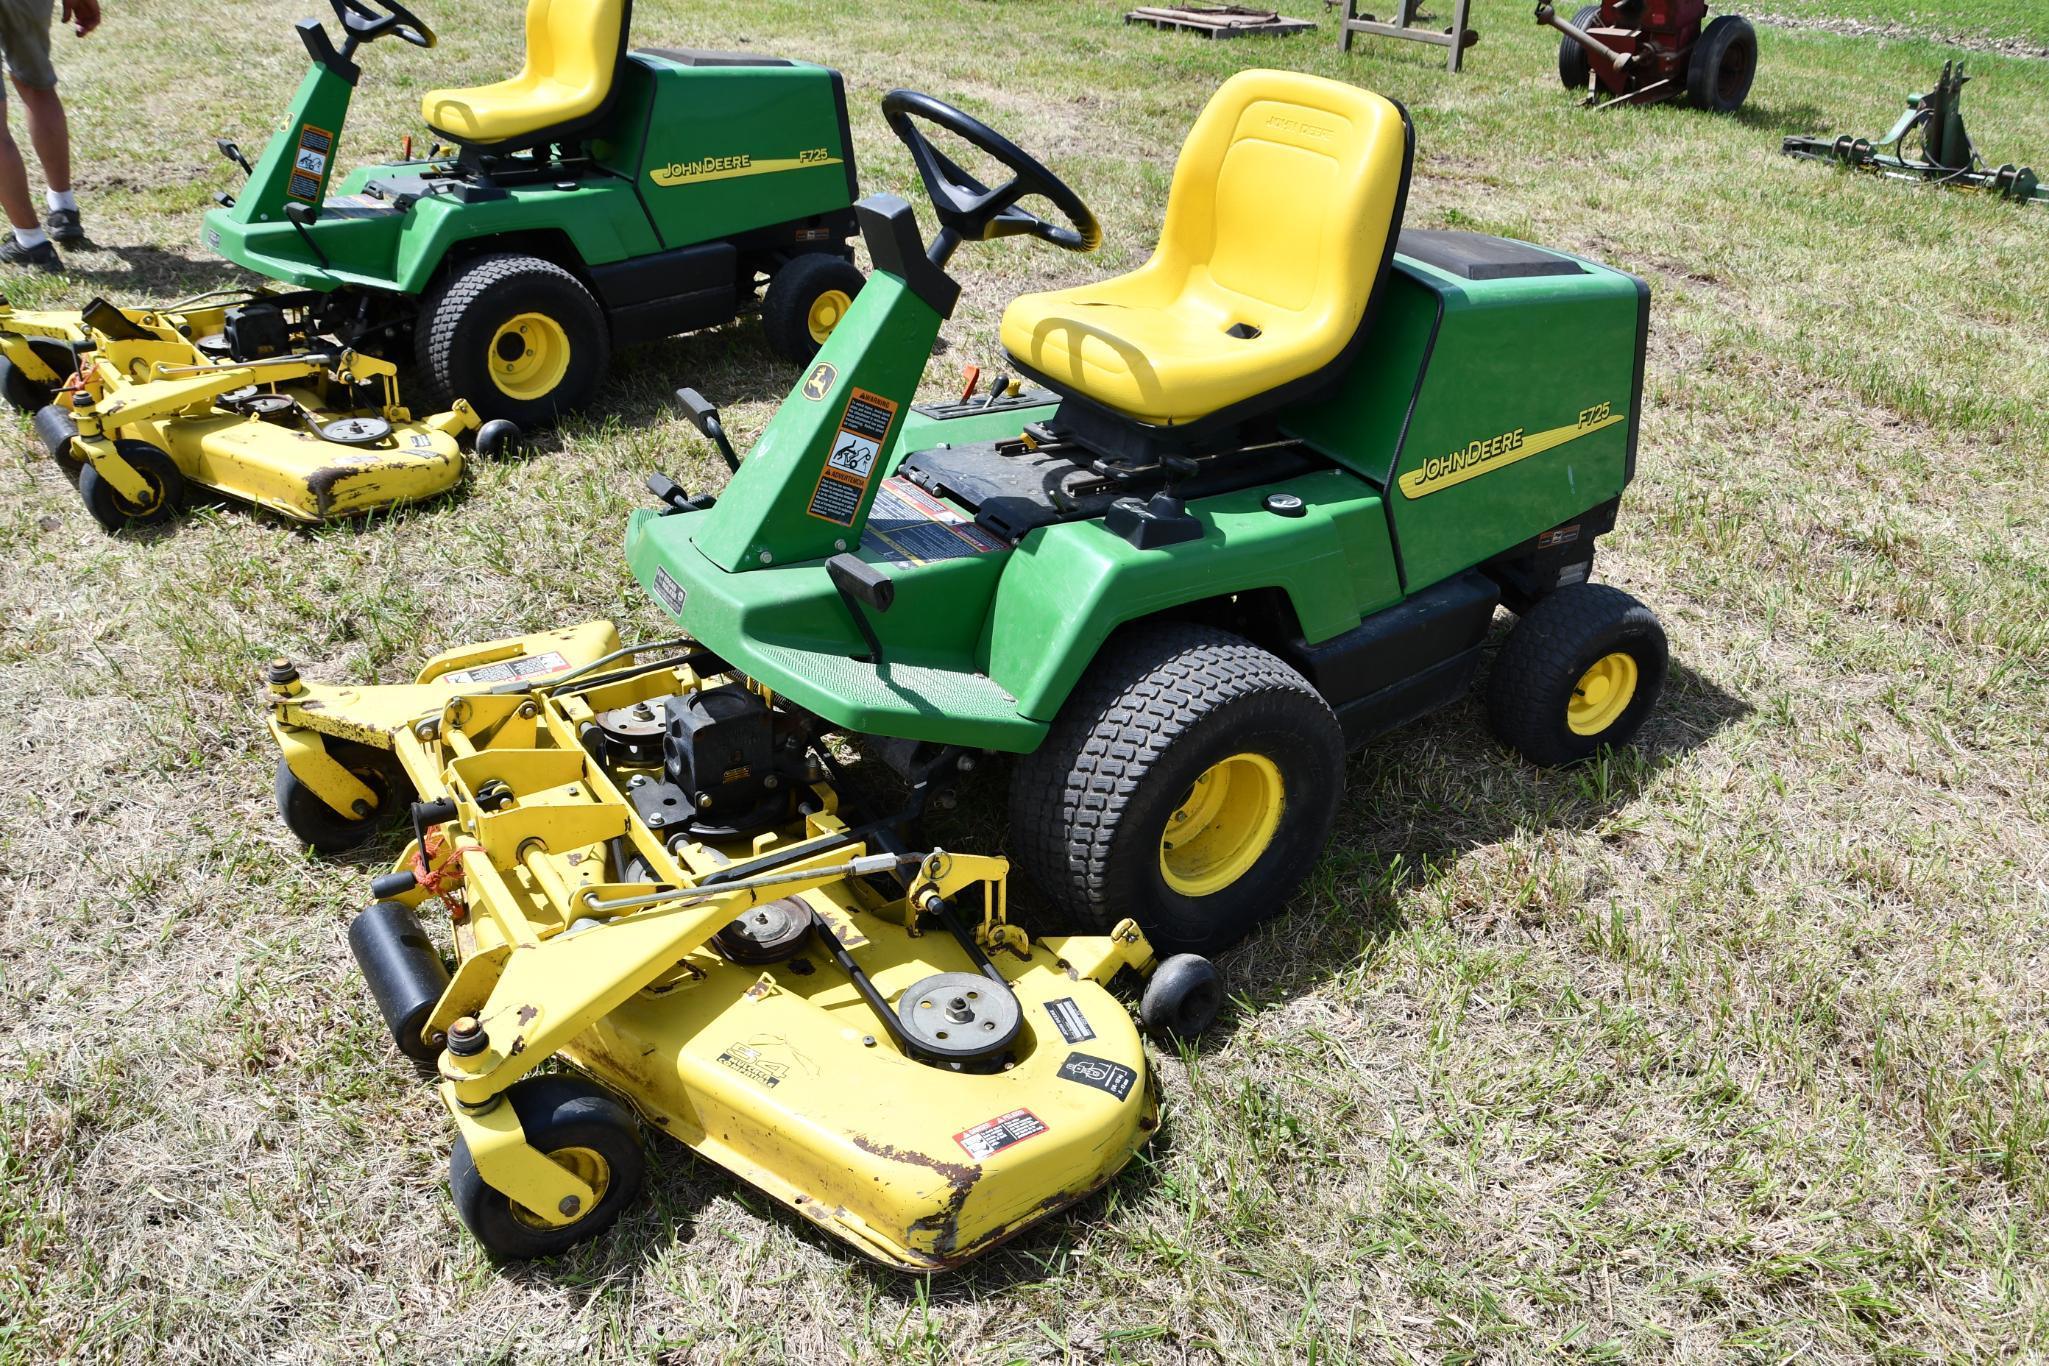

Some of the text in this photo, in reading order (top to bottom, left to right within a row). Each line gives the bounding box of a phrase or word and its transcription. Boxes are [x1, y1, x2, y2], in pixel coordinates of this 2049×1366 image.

[663, 154, 752, 179] JOHN DEERE
[799, 148, 828, 163] F725
[864, 392, 890, 408] WARNING
[1577, 401, 1611, 430] F725
[1414, 427, 1525, 485] JOHN DEERE
